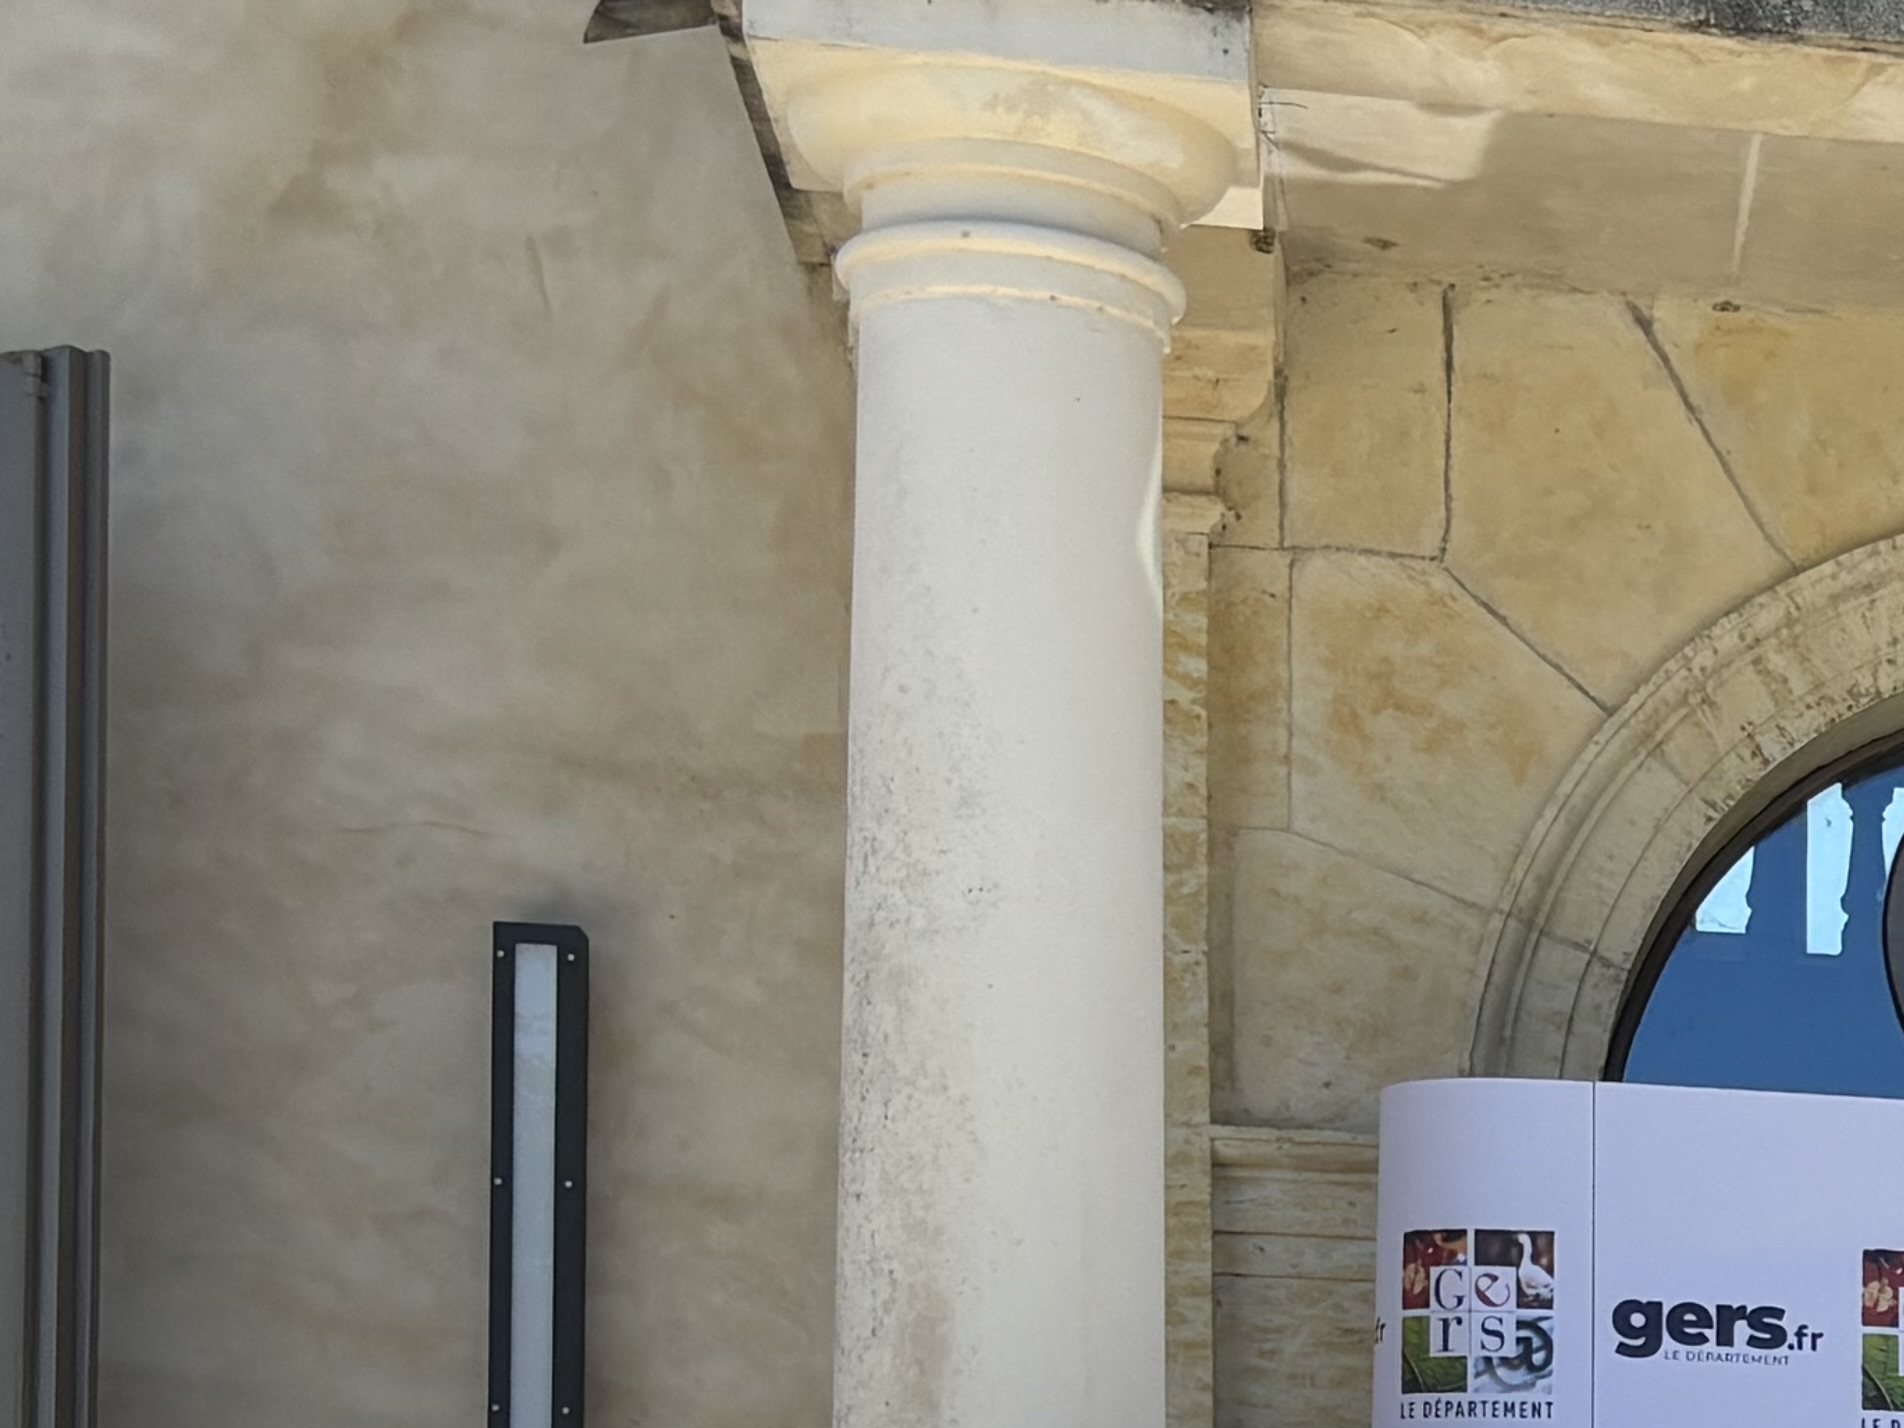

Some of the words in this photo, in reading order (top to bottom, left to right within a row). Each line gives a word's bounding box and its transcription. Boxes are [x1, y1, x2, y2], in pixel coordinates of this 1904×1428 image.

[1612, 1299, 1824, 1358] gers.fr
[1401, 1401, 1414, 1419] LE
[1424, 1398, 1553, 1419] DÉPARTEMENT
